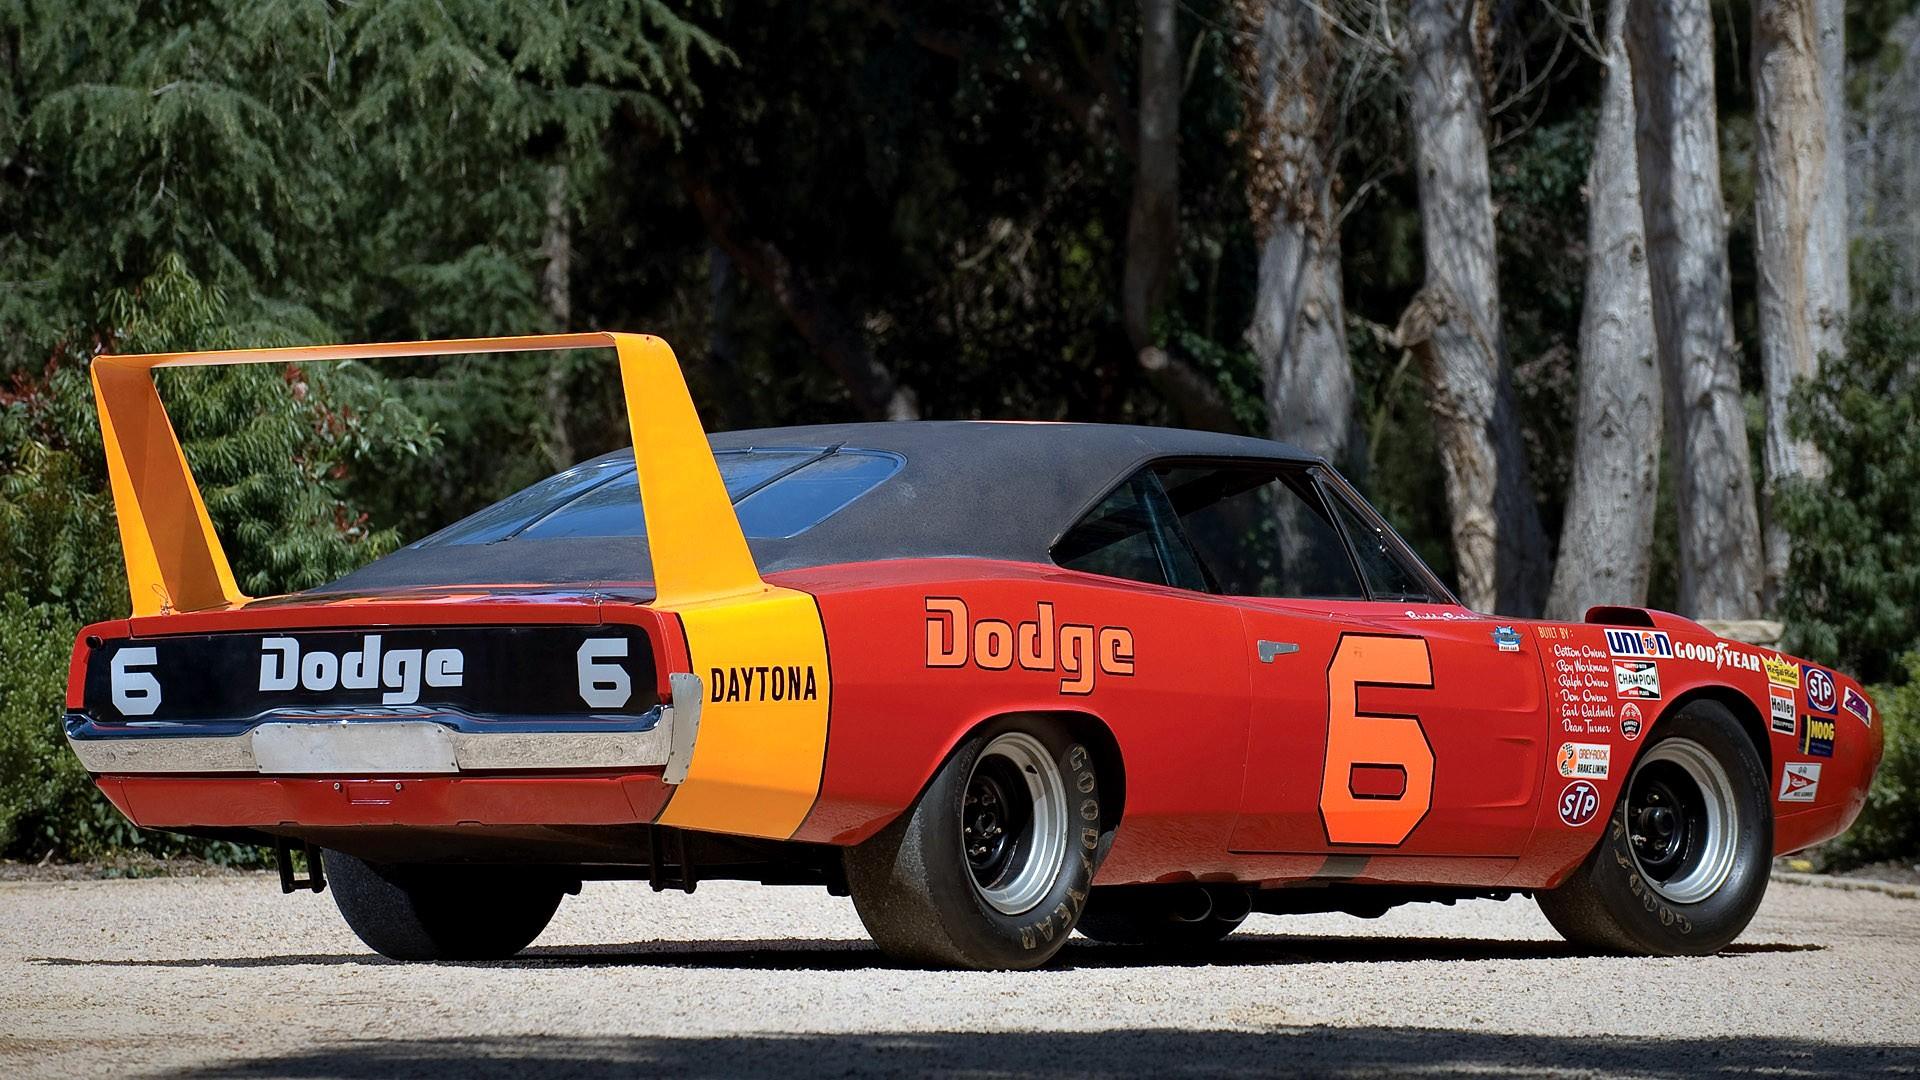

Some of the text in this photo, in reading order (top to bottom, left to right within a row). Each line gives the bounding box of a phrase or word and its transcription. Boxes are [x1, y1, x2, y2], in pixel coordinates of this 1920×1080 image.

[1538, 626, 1558, 638] BUILT
[925, 596, 1135, 696] Dodge
[1553, 644, 1607, 659] Cotton Owens
[1644, 637, 1654, 649] 76
[1556, 658, 1610, 674] Roy Workman
[1674, 641, 1760, 673] GOODYEAR
[259, 635, 463, 705] Dodge
[576, 638, 632, 708] 6
[1618, 673, 1656, 686] CHAMPION
[110, 647, 162, 715] 6
[711, 666, 817, 702] DAYTONA
[1558, 673, 1609, 690] Ralph Owens
[1809, 673, 1831, 701] STP
[1560, 689, 1608, 702] Don Owens
[1561, 703, 1579, 717] Earl
[1581, 703, 1616, 718] Caldwell
[1771, 698, 1794, 717] Holley
[1562, 718, 1611, 734] Dean Turner
[1811, 720, 1834, 741] MOOG
[1318, 631, 1437, 848] 6
[1577, 763, 1607, 775] BRAKE LINING
[1562, 786, 1595, 820] STP
